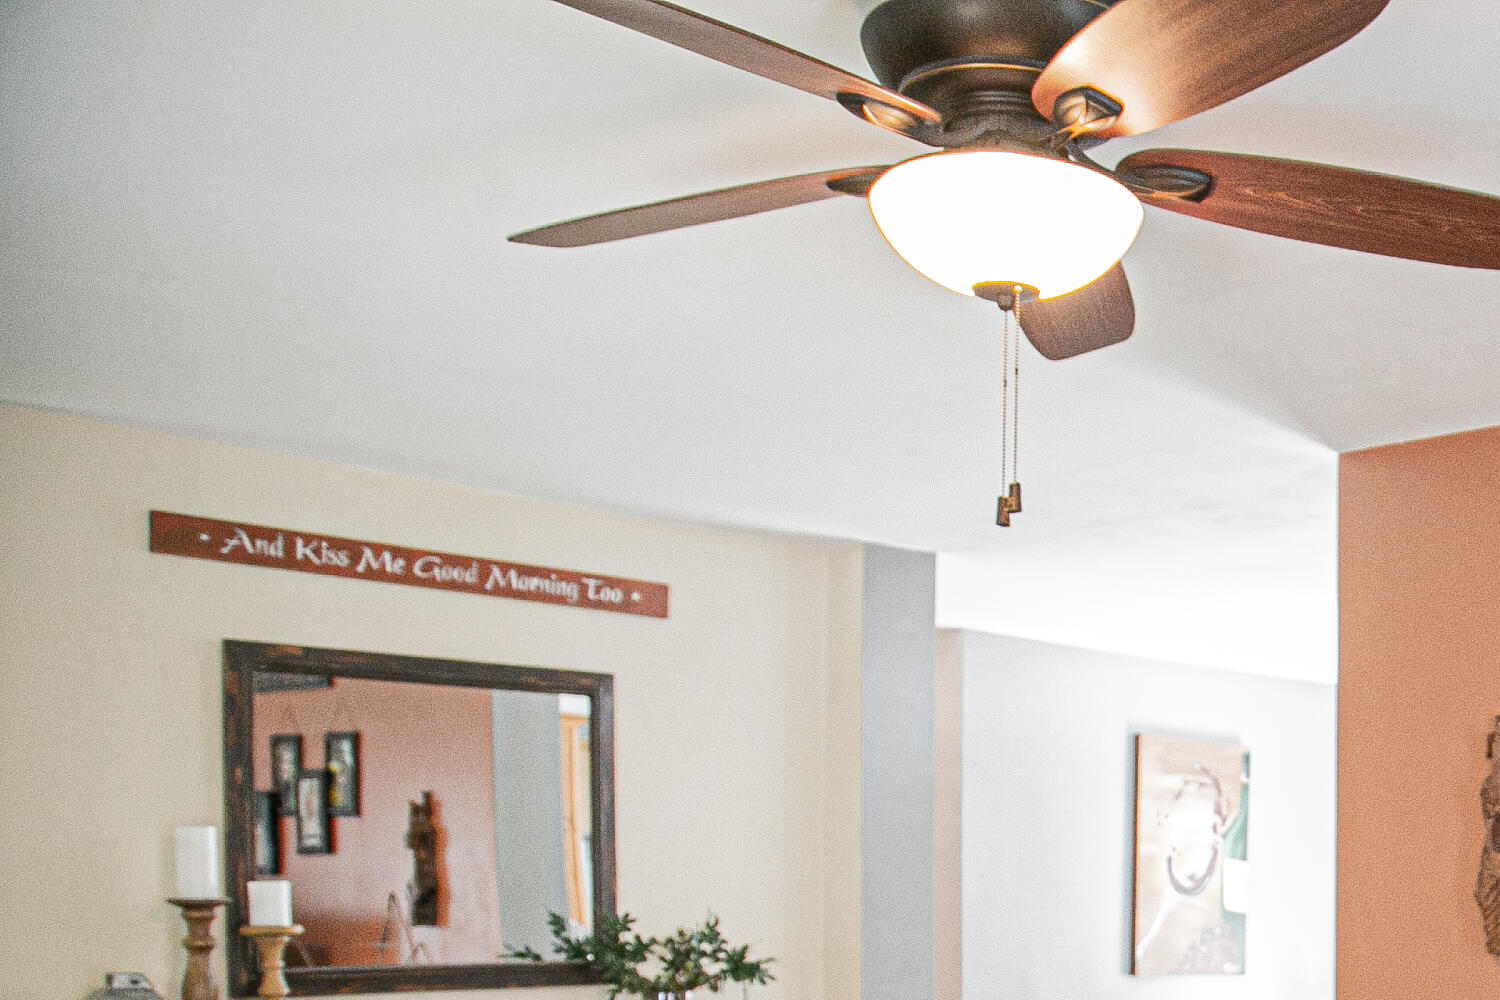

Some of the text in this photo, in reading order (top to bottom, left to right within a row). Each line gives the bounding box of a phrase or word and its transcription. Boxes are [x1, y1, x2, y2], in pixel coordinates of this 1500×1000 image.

[220, 527, 624, 604] And Kiss Me Good Morning Too
